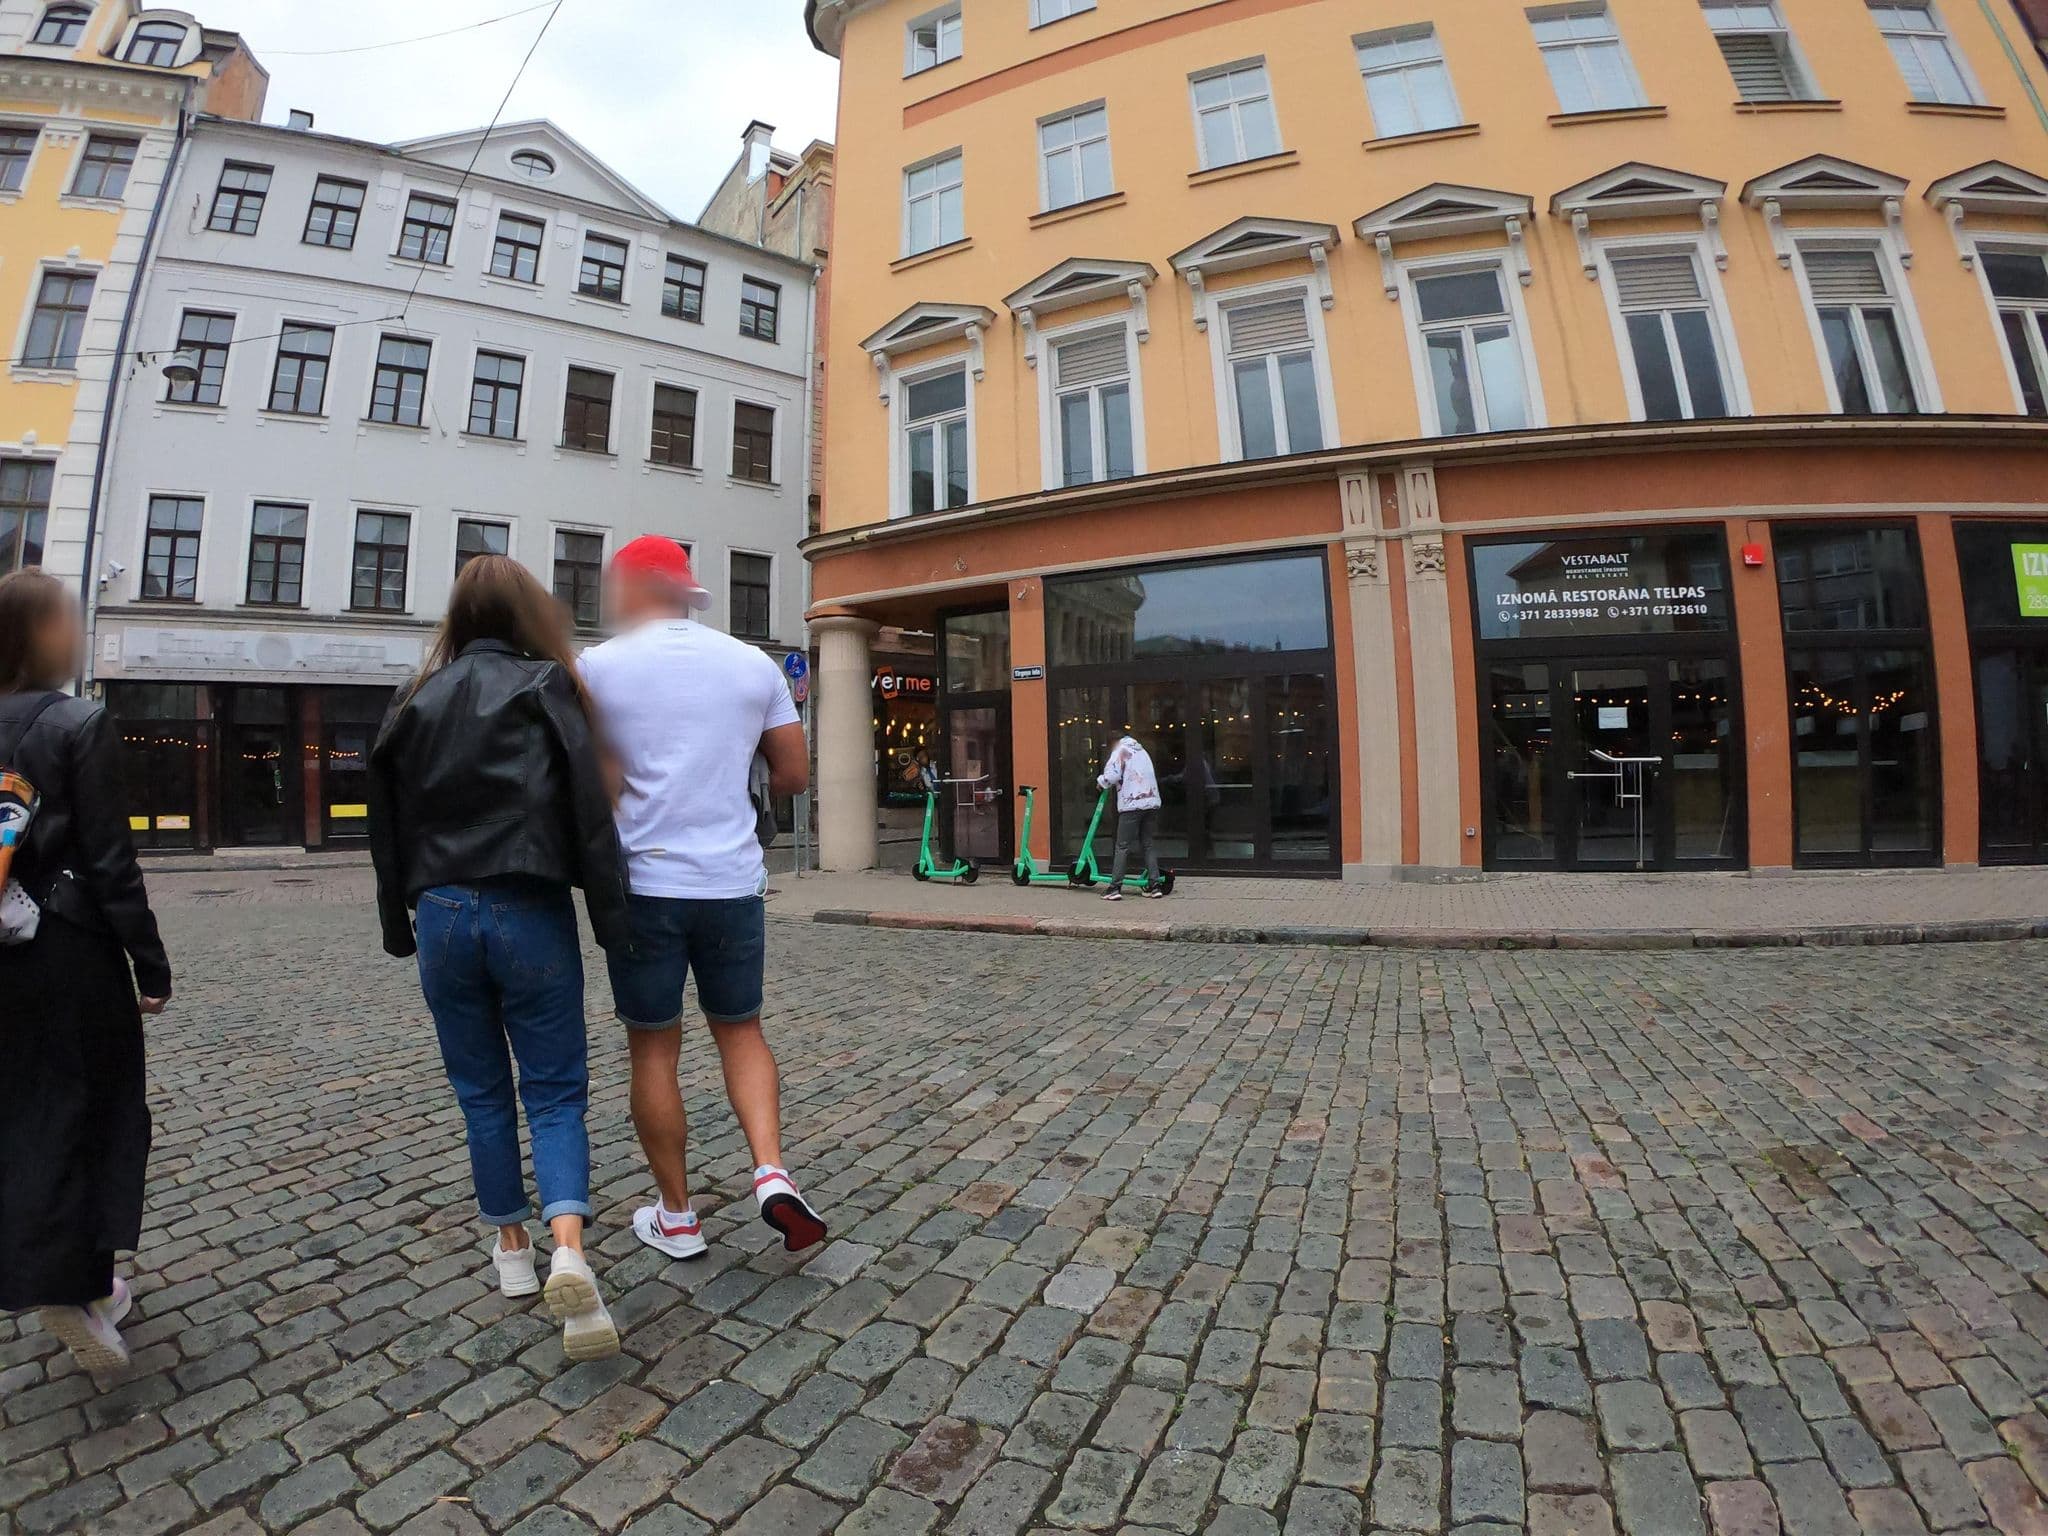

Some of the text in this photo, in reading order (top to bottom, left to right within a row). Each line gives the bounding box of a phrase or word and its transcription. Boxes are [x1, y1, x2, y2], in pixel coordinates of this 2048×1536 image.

[1561, 553, 1630, 566] VESTABALT
[1496, 586, 1706, 606] IZNOMĀ RESTORĀNA TELPAS
[1512, 604, 1708, 620] +371 28339982 +371 67323610
[650, 1220, 661, 1237] N
